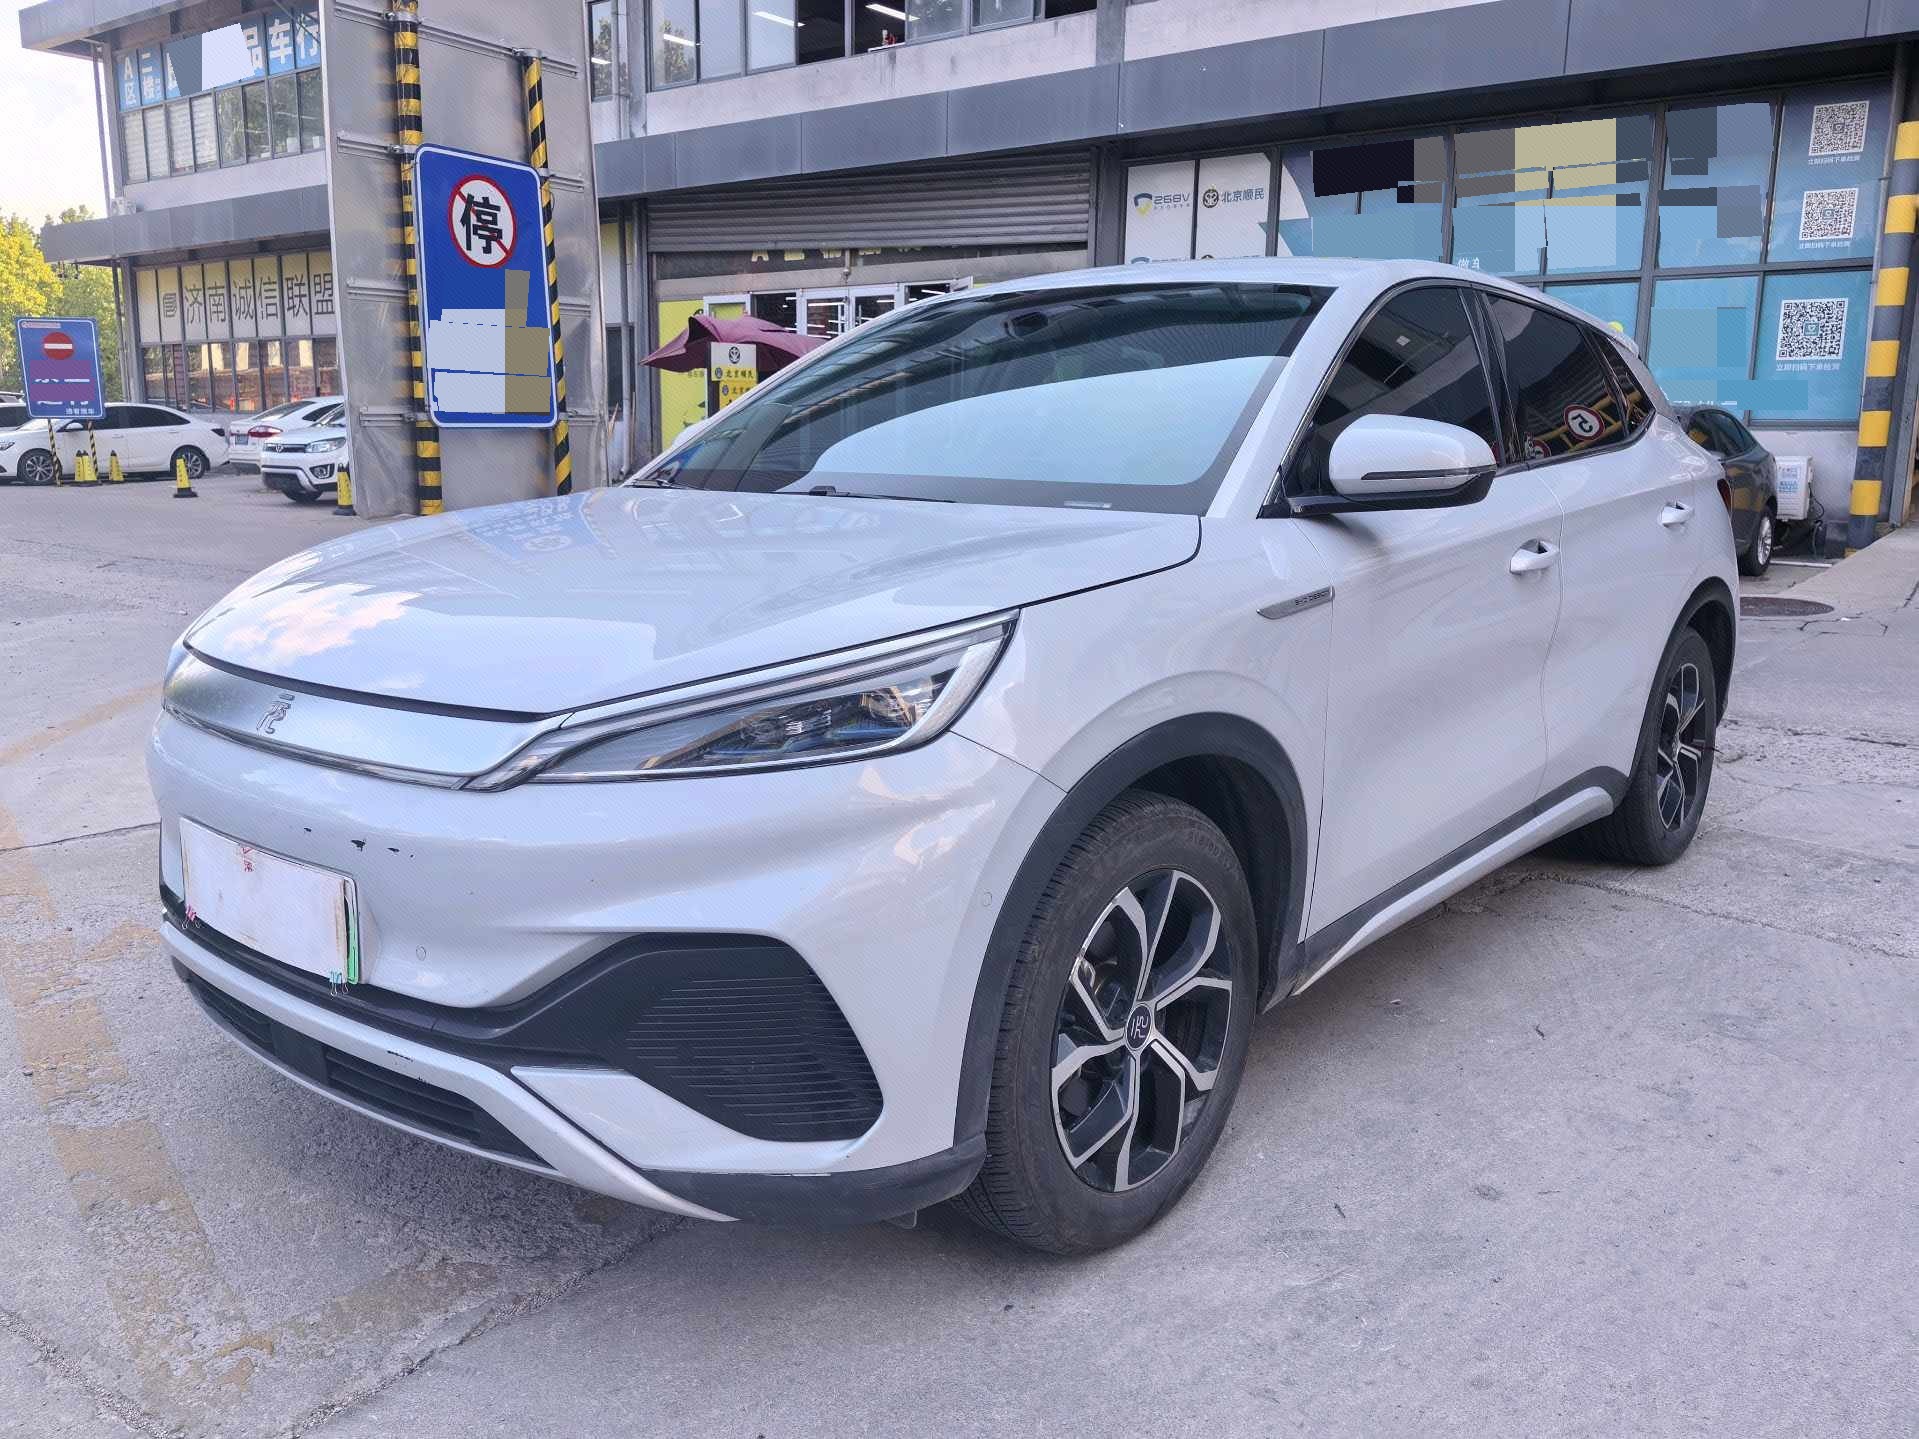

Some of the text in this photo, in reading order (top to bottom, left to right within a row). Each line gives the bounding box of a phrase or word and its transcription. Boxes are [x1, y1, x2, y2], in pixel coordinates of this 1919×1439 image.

[1222, 188, 1264, 202] 北京顺民
[460, 193, 503, 254] 停
[184, 272, 335, 324] 济南诚信联盟
